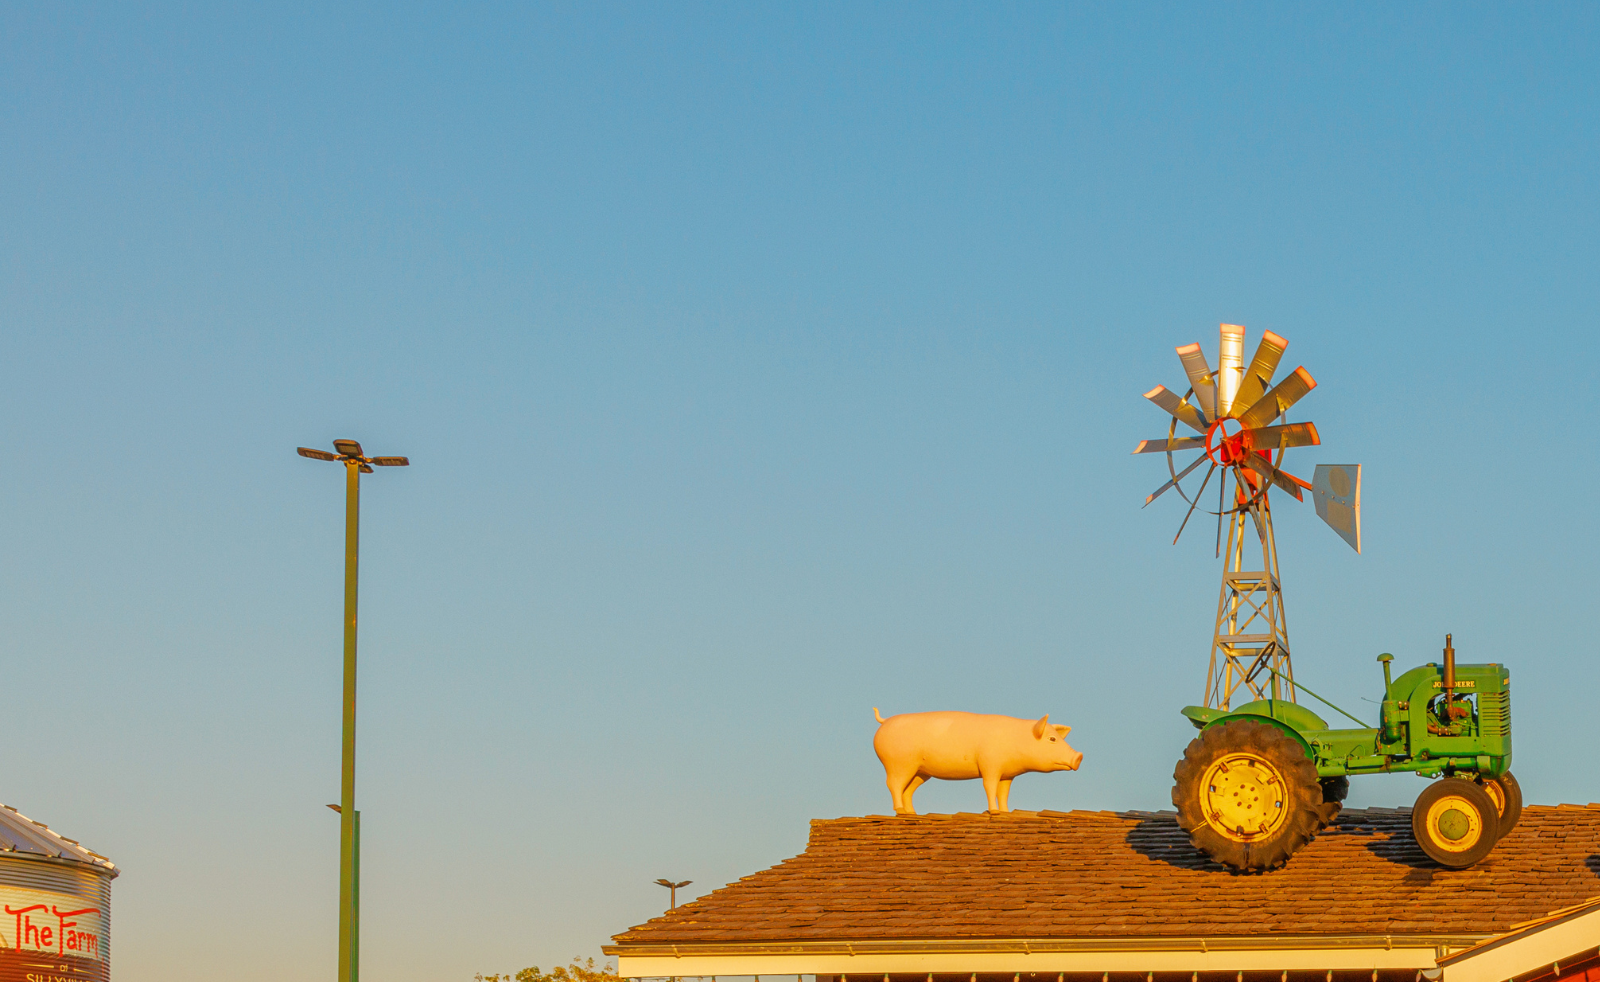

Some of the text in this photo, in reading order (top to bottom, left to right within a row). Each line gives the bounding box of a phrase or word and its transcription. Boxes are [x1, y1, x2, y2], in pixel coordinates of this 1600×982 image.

[5, 904, 101, 958] The Farm
[59, 963, 69, 972] at
